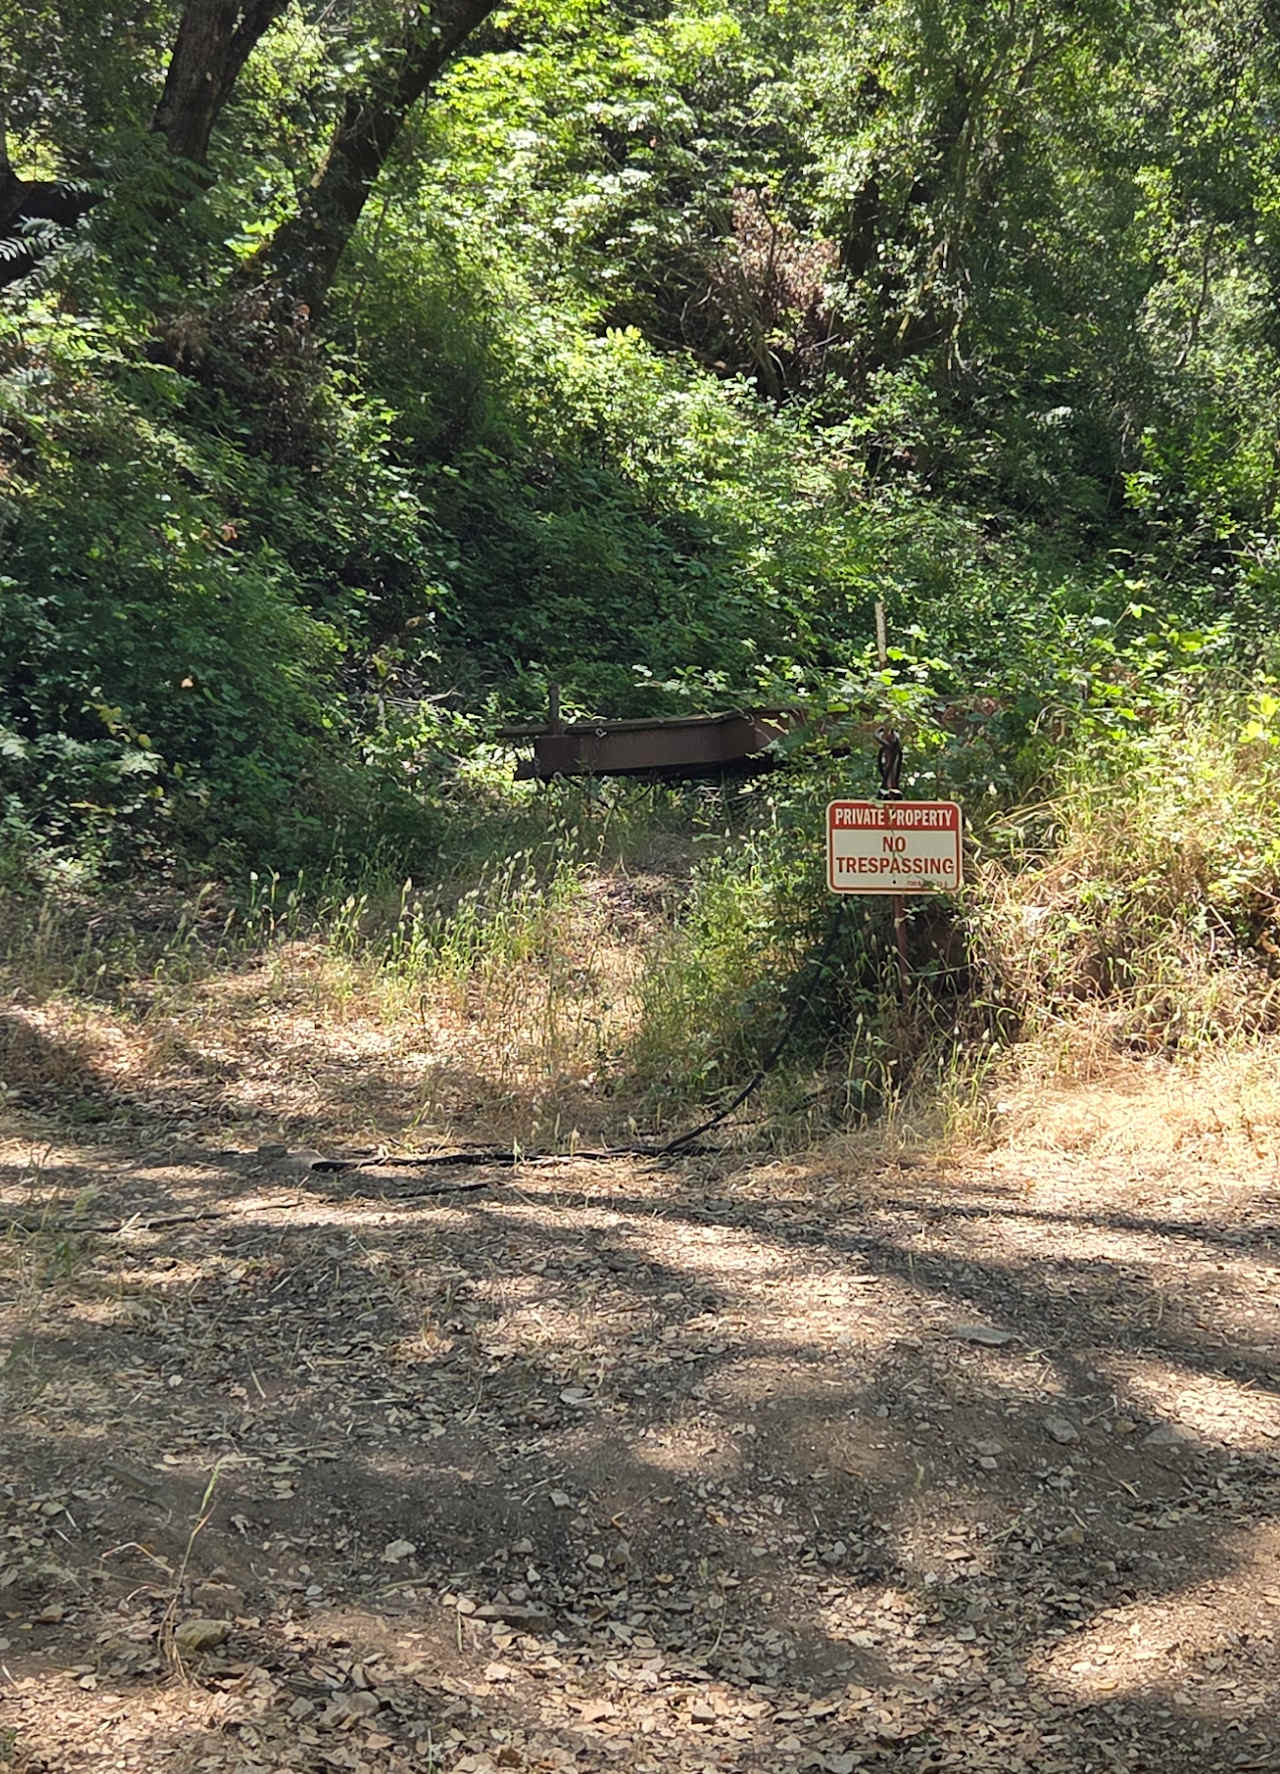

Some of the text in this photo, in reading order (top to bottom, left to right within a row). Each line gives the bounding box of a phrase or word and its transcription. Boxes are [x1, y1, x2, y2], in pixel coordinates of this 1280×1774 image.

[835, 808, 953, 827] PRIVATE PROPERTY
[882, 836, 907, 852] NO
[836, 856, 954, 875] TRESPASSING
